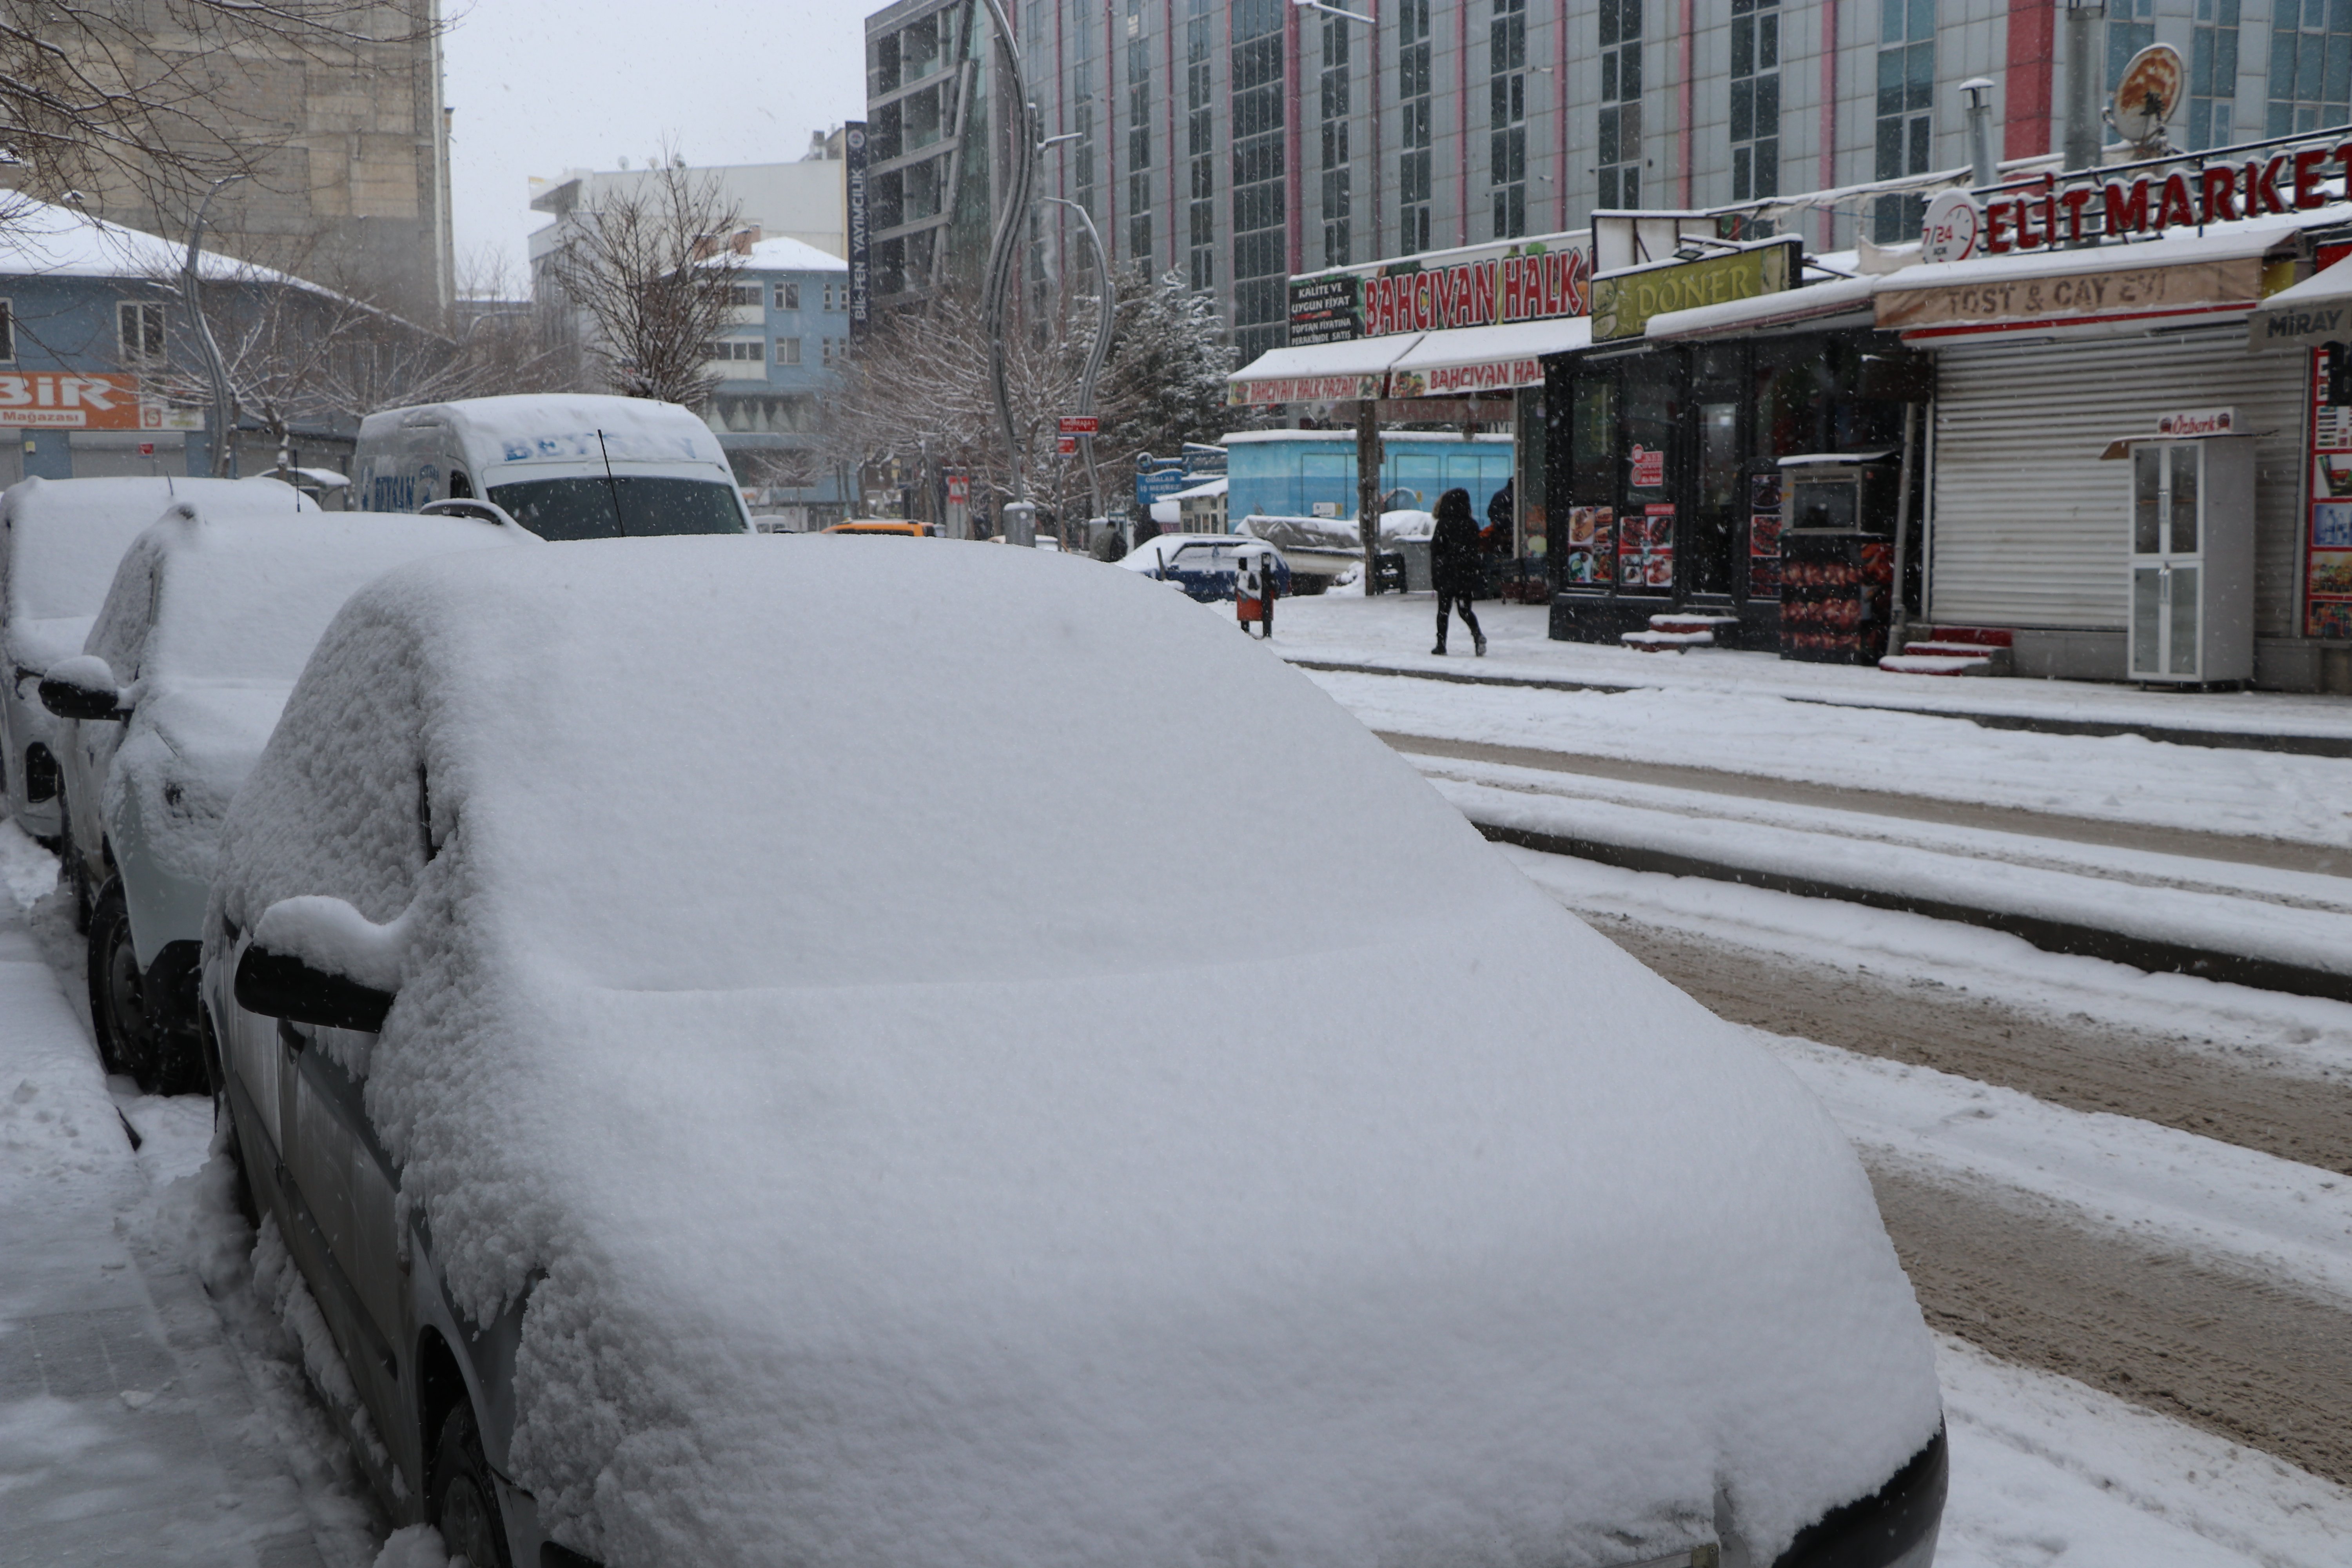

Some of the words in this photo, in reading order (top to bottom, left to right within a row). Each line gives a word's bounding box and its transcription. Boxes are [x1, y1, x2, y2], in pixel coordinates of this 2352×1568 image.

[1987, 173, 2090, 254] ELİT
[1922, 225, 1953, 246] 7/24
[1299, 283, 1329, 299] KALİTE
[1330, 282, 1343, 293] VE
[1503, 247, 1583, 321] HALK
[1636, 265, 1751, 316] DÖNER
[1292, 300, 1323, 312] UYGUN
[1325, 295, 1351, 308] FİYAT
[1947, 287, 2015, 314] TOST
[2025, 286, 2043, 311] &
[1292, 322, 1318, 333] TOPTAN
[1319, 318, 1351, 330] FİYATINA
[2267, 309, 2343, 338] MİRAY
[1332, 330, 1351, 340] SATIŞ
[1296, 378, 1321, 398] HALK
[1323, 376, 1357, 397] PAZARI
[3, 411, 79, 423] Mağazası
[2173, 414, 2215, 434] Özberk
